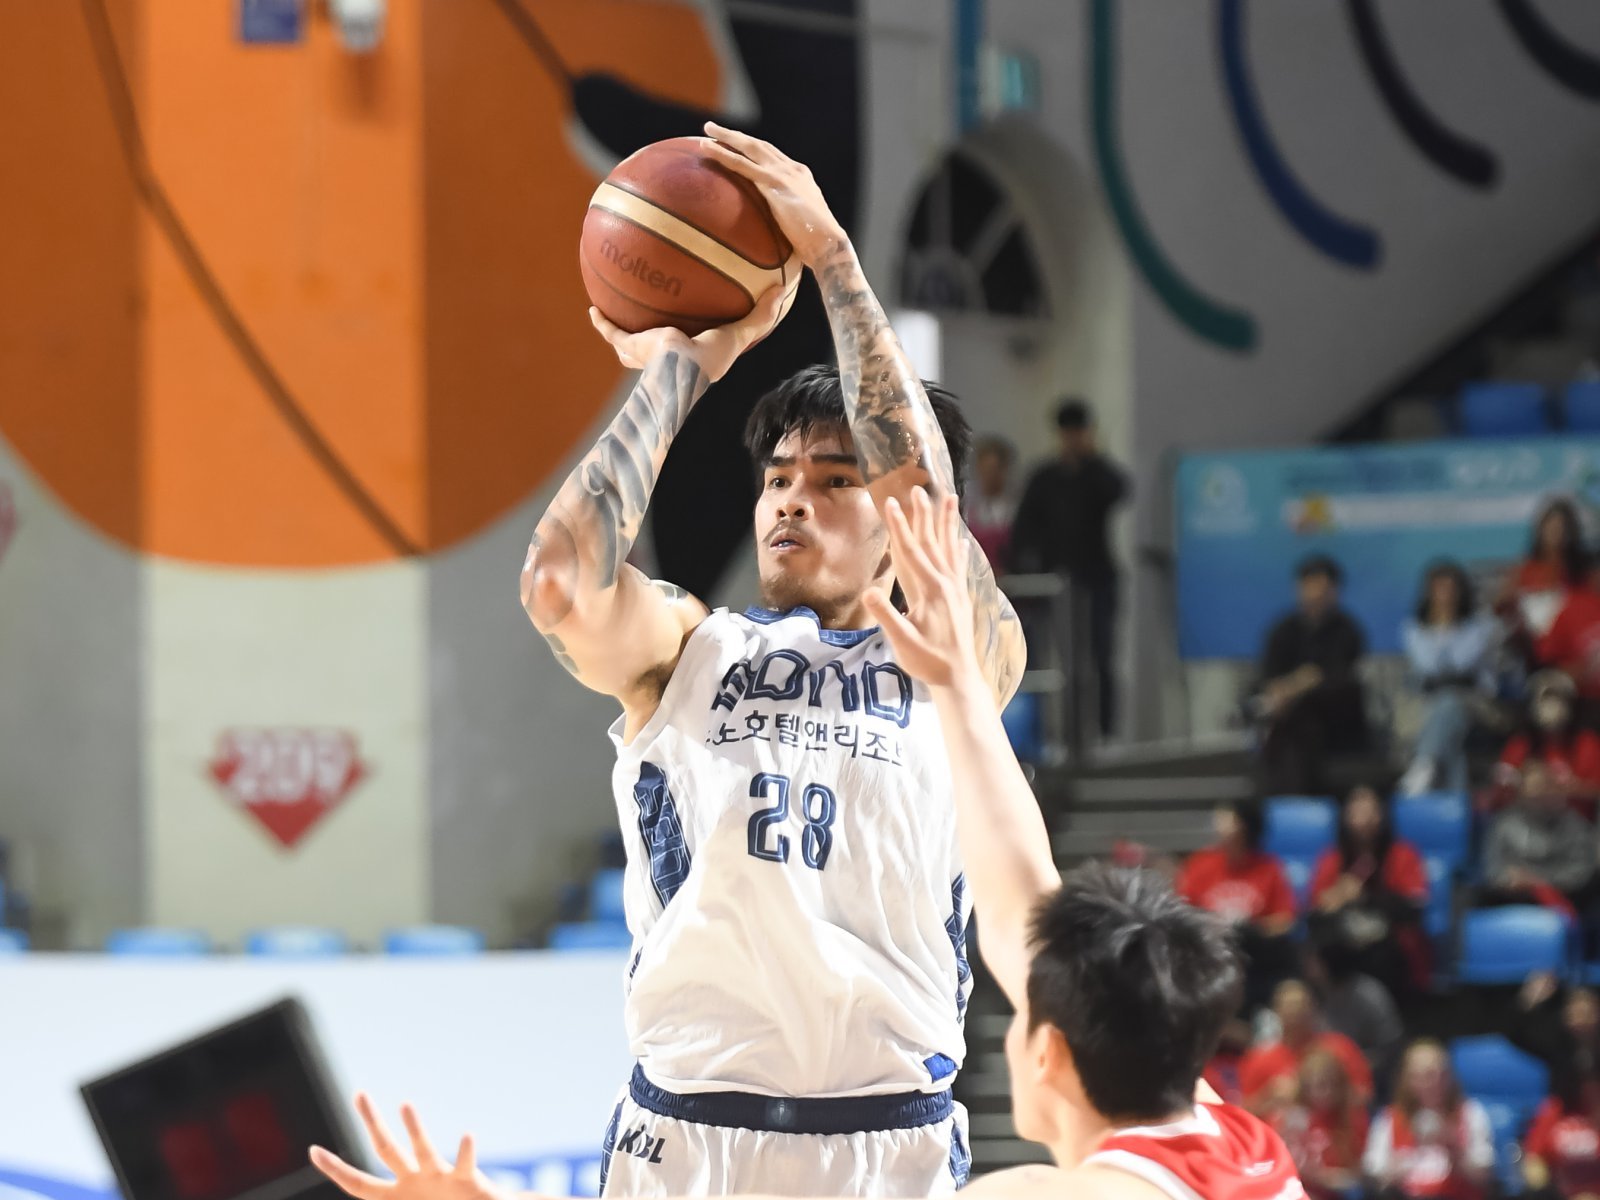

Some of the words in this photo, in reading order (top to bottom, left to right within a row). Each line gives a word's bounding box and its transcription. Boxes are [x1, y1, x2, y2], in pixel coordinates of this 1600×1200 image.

[600, 238, 684, 297] molten
[706, 709, 902, 766] 노호텔앤리조
[747, 771, 837, 871] 28
[616, 1123, 666, 1164] KBL
